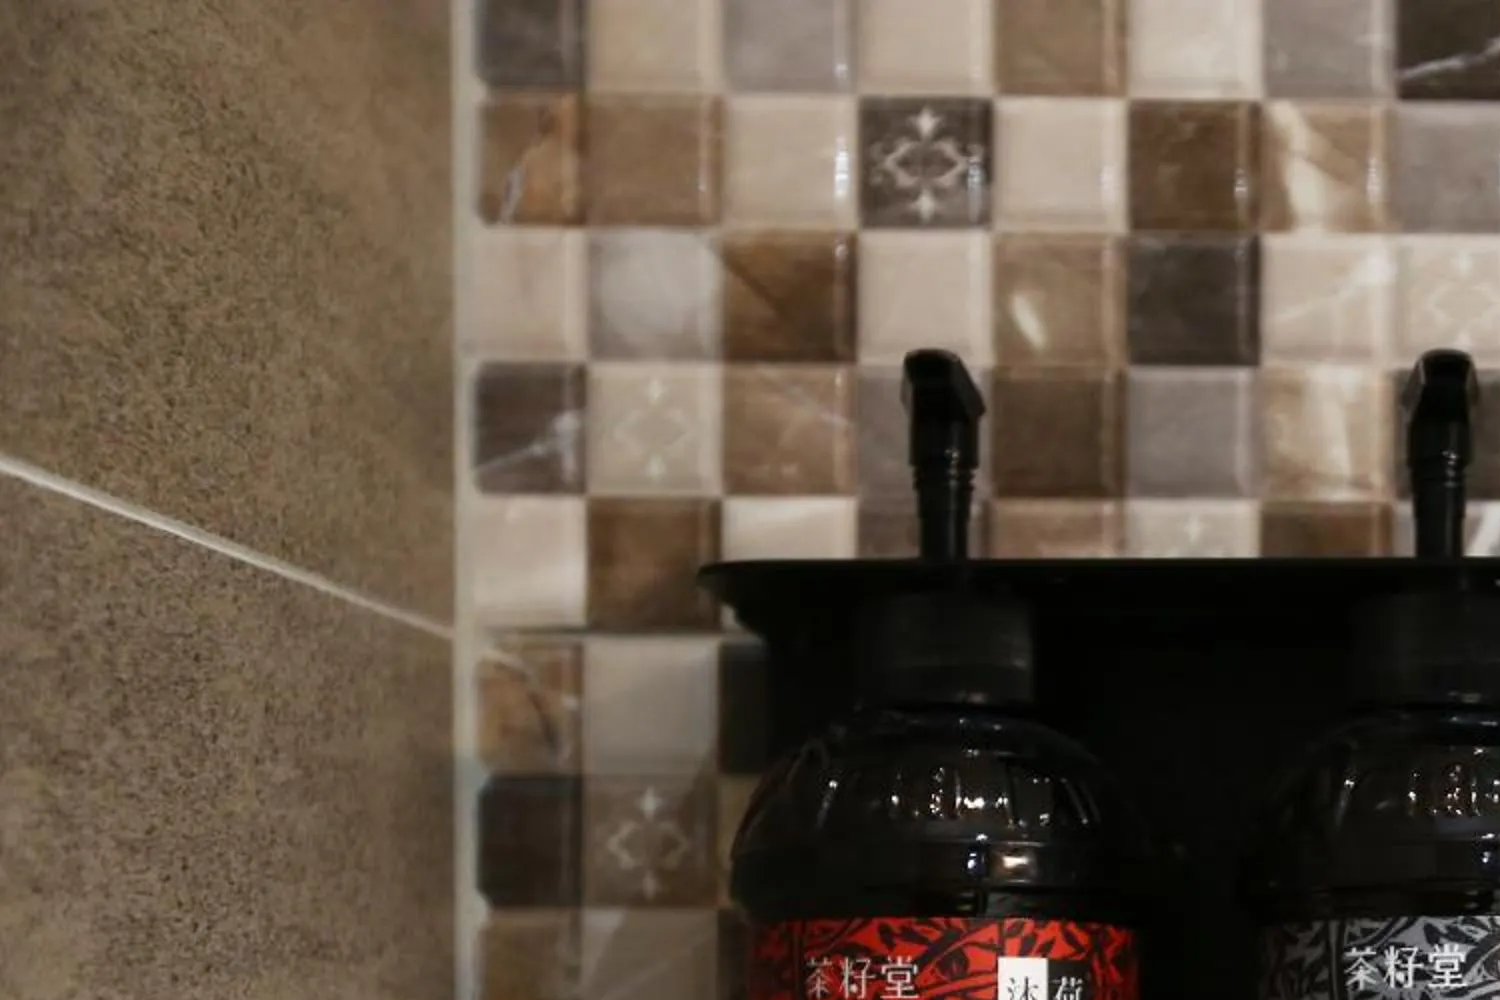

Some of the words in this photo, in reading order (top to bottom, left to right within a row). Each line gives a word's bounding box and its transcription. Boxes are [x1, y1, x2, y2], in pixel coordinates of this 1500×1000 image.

[805, 955, 920, 1000] 茶籽堂
[1343, 943, 1470, 990] 茶籽堂
